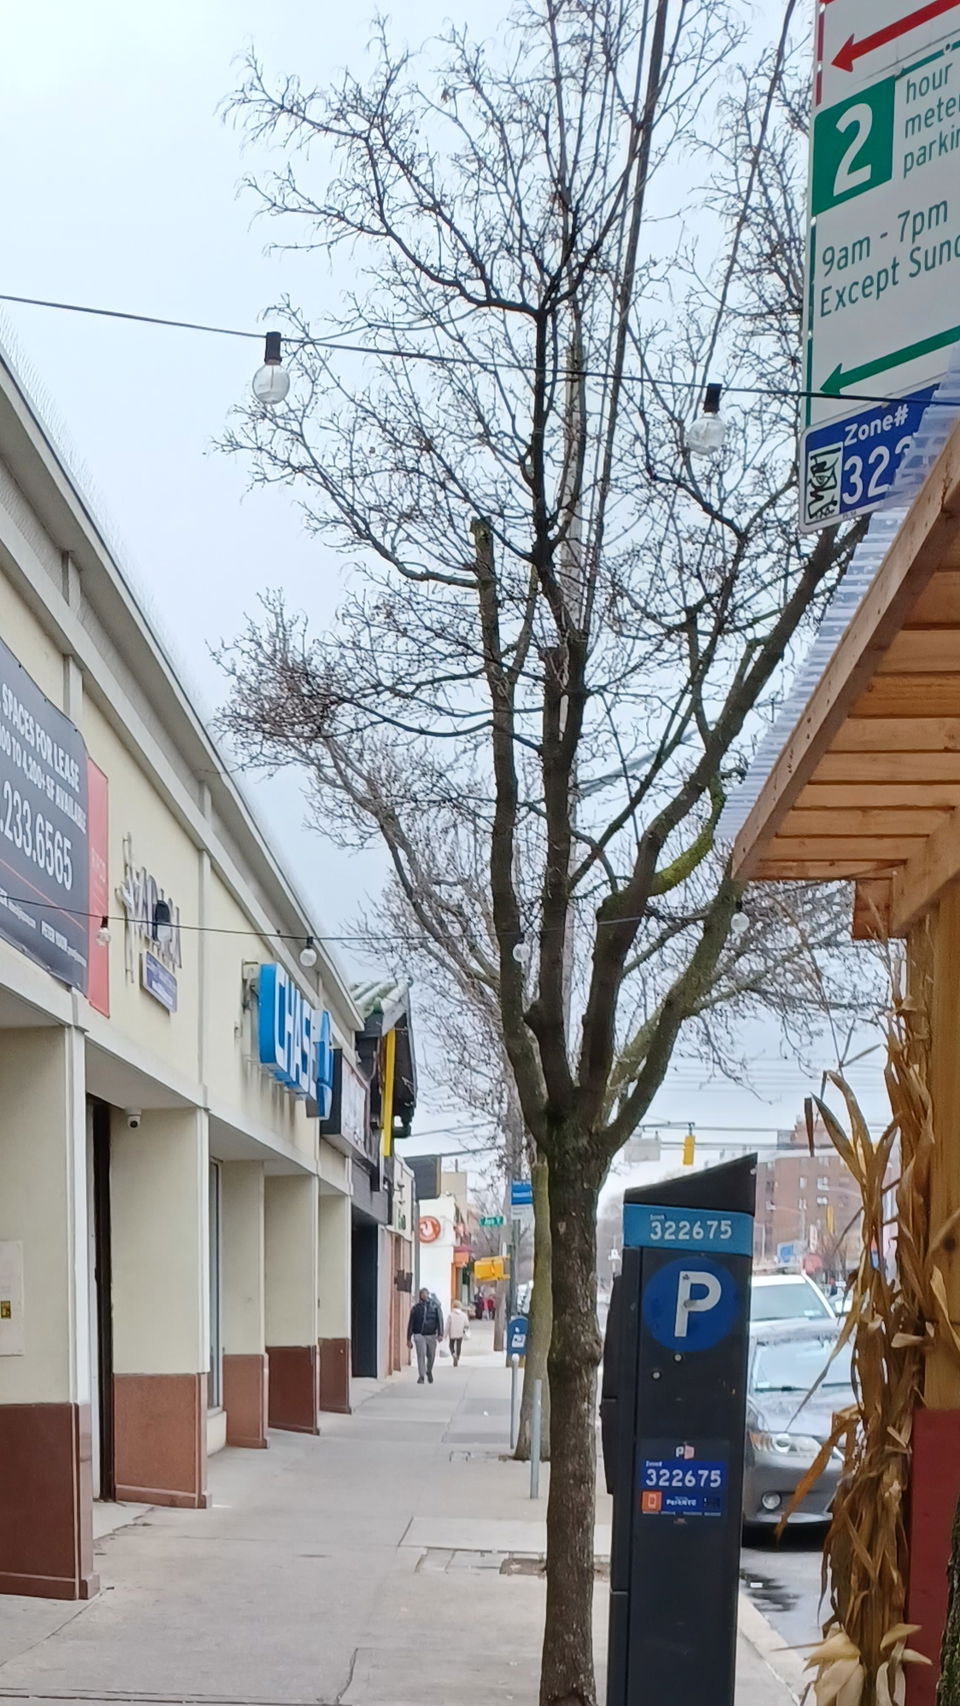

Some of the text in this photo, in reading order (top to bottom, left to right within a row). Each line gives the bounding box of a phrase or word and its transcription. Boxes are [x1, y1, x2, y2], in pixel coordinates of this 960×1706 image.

[905, 62, 953, 105] hour
[833, 102, 874, 197] 2
[822, 236, 871, 277] 9am
[897, 199, 948, 245] 7pm
[820, 256, 900, 318] Except
[844, 403, 909, 446] Zone#
[2, 683, 35, 747] SPACES
[36, 722, 54, 768] FOR
[53, 742, 80, 793] LEASE
[12, 736, 22, 768] TO
[650, 1220, 732, 1240] 322675
[674, 1270, 722, 1338] P
[645, 1468, 722, 1488] 322675
